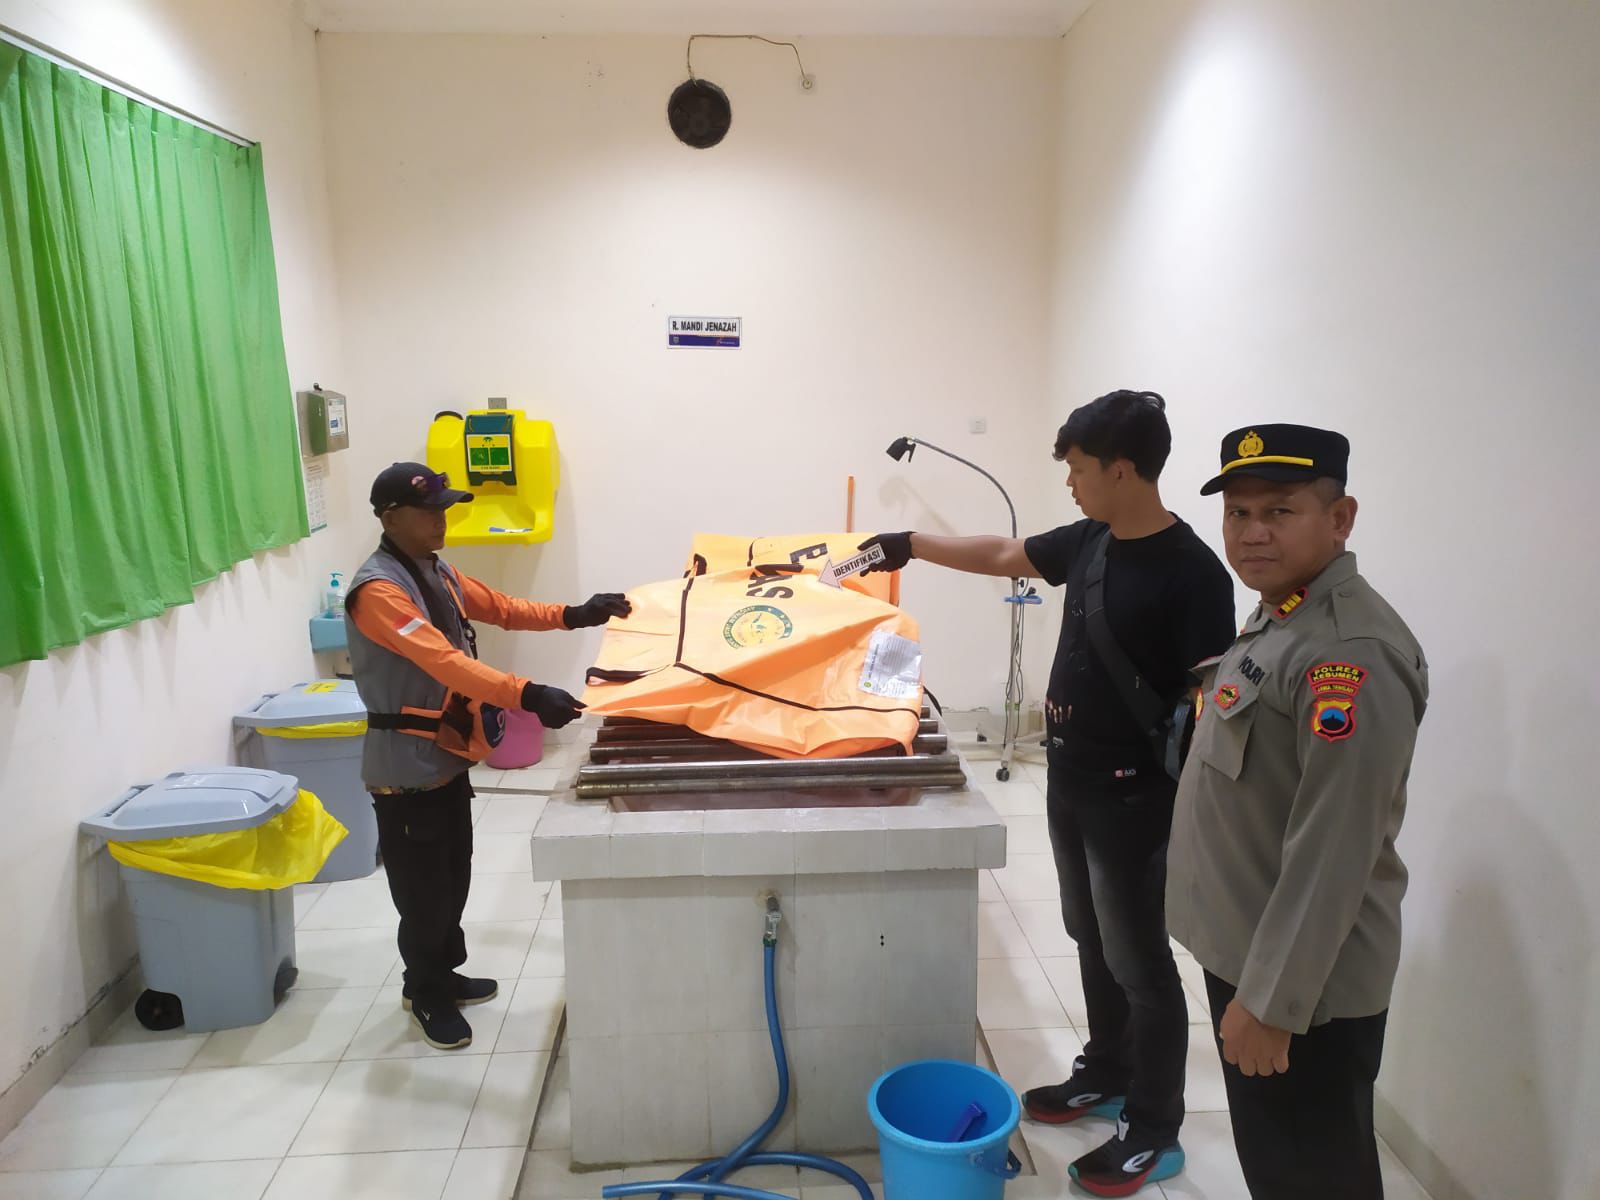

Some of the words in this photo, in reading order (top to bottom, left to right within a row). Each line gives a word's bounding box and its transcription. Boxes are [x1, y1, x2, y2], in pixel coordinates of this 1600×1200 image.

[672, 320, 679, 331] R.
[681, 321, 703, 331] MANDI
[704, 322, 737, 332] JENAZAH
[833, 549, 881, 577] IDENTIFIKASI
[1238, 655, 1266, 686] POLRI
[1314, 666, 1359, 676] POLRES
[1313, 672, 1360, 682] KEBUMEN
